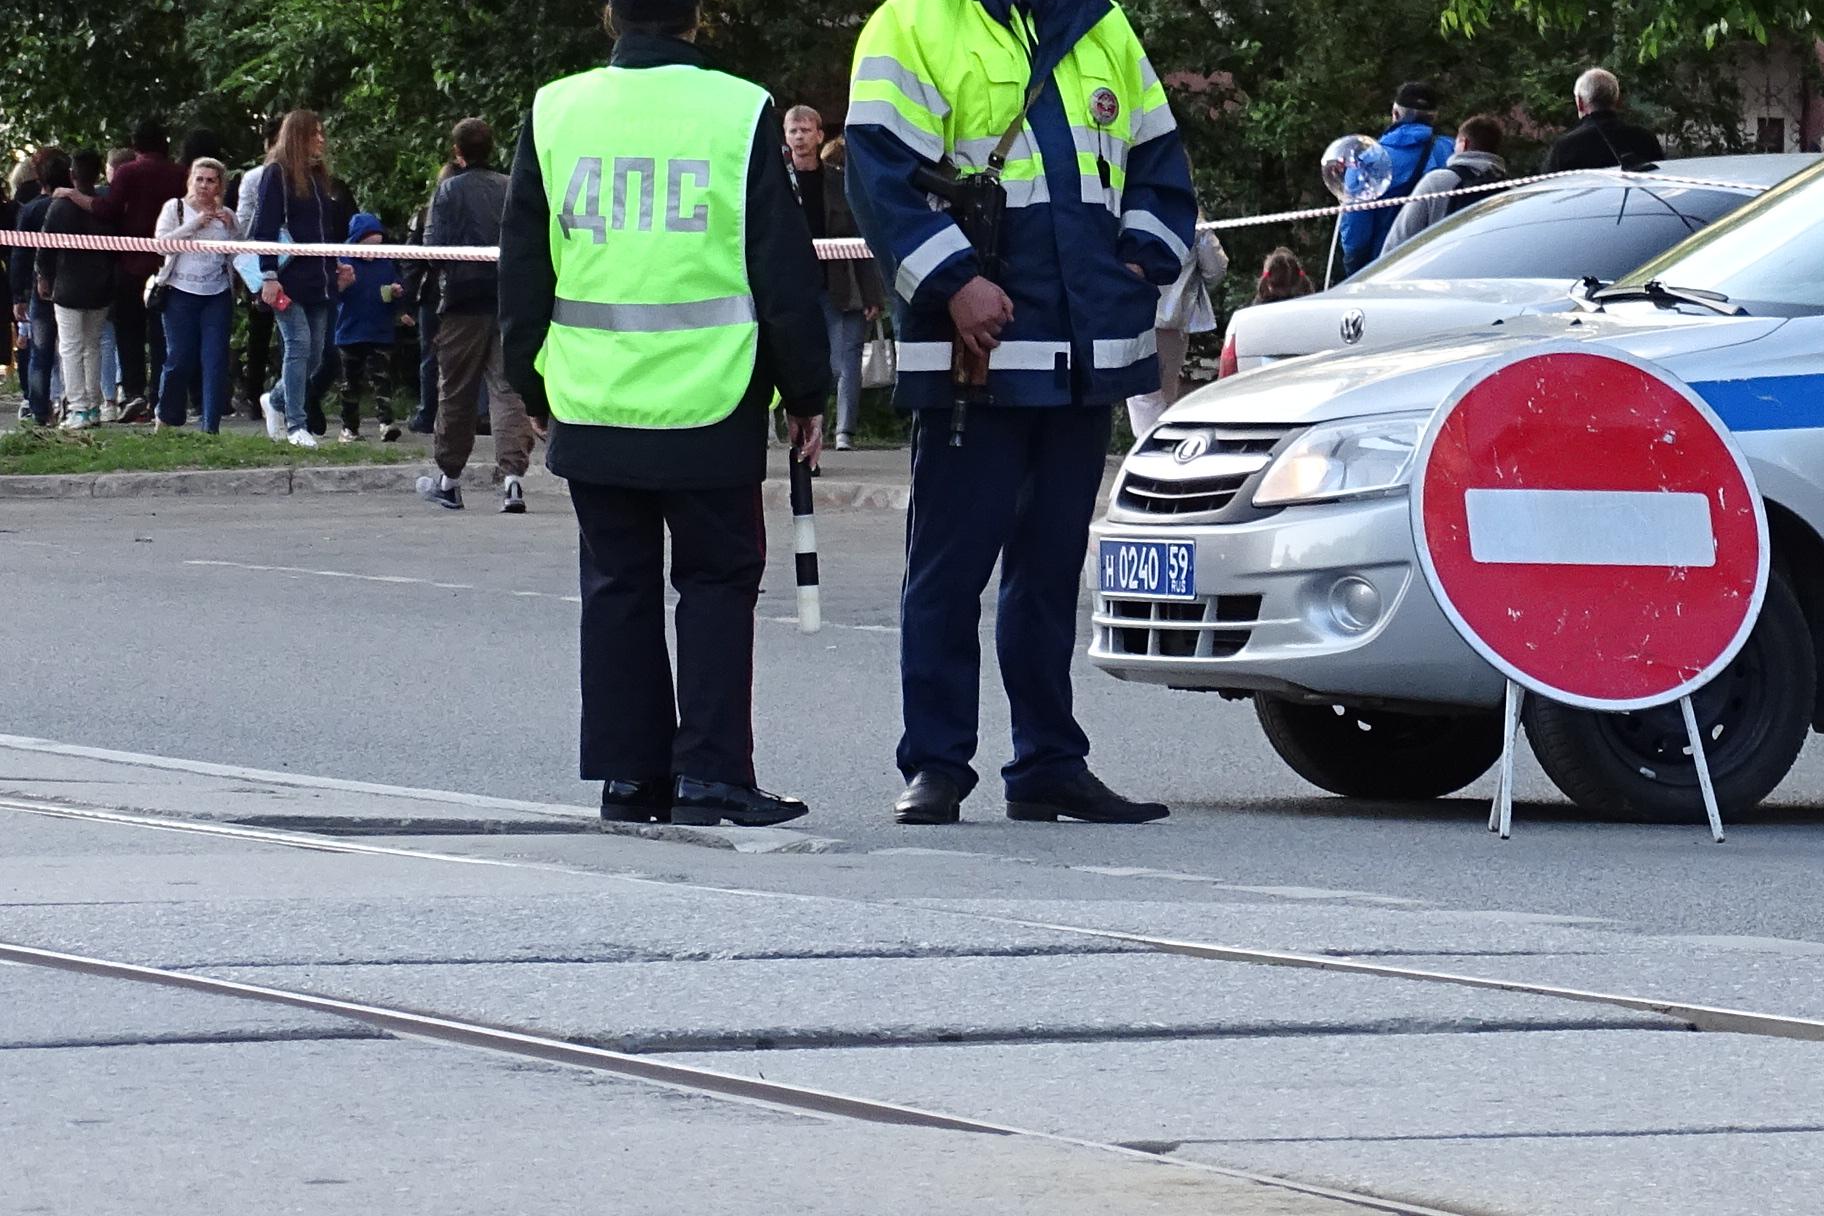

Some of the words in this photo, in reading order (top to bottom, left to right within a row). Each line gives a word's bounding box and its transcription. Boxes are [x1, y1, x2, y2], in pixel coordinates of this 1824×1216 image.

[556, 156, 711, 245] ДПС
[1119, 545, 1159, 590] 0240
[1168, 546, 1189, 580] 59
[1170, 579, 1187, 593] RUS
